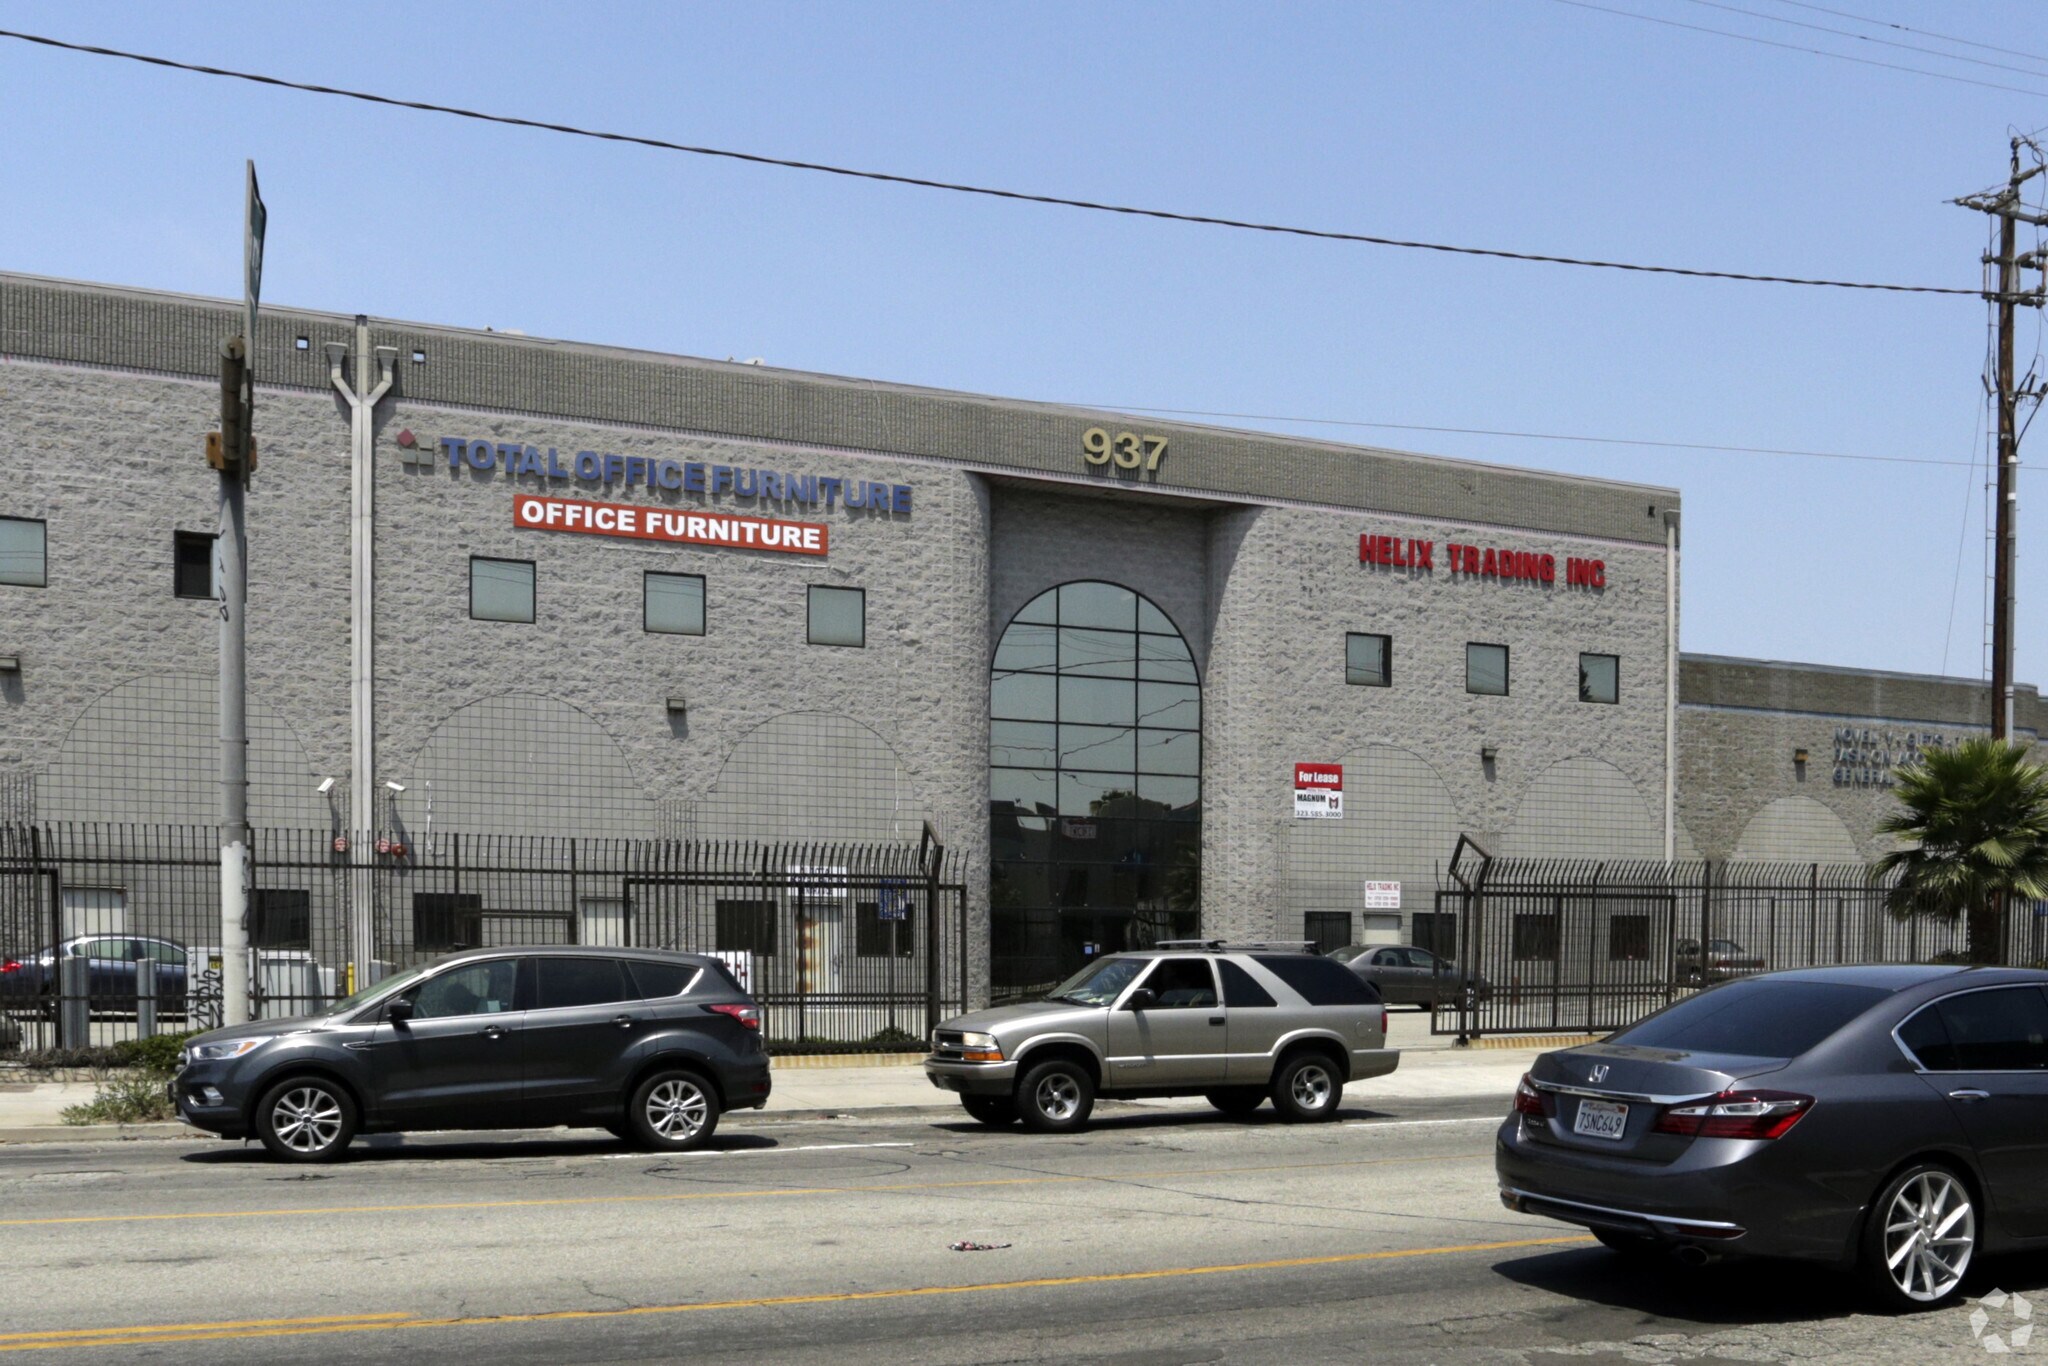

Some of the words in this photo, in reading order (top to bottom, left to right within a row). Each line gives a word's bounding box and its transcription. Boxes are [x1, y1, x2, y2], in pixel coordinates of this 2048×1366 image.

[1082, 427, 1168, 471] 937
[441, 437, 569, 479] TOTAL
[574, 450, 706, 492] OFFICE
[712, 465, 912, 514] FURNITURE
[522, 500, 636, 533] OFFICE
[645, 512, 822, 550] FURNITURE
[1359, 534, 1434, 570] HELIX
[1447, 543, 1555, 582] TRADING
[1567, 556, 1606, 588] INC
[1833, 727, 1893, 745] NOVELY
[1833, 747, 1891, 765] FASHON
[1299, 771, 1312, 782] For
[1314, 772, 1339, 783] Lease
[1297, 794, 1326, 802] MAGNUM
[1579, 1112, 1622, 1133] 7SNC649
